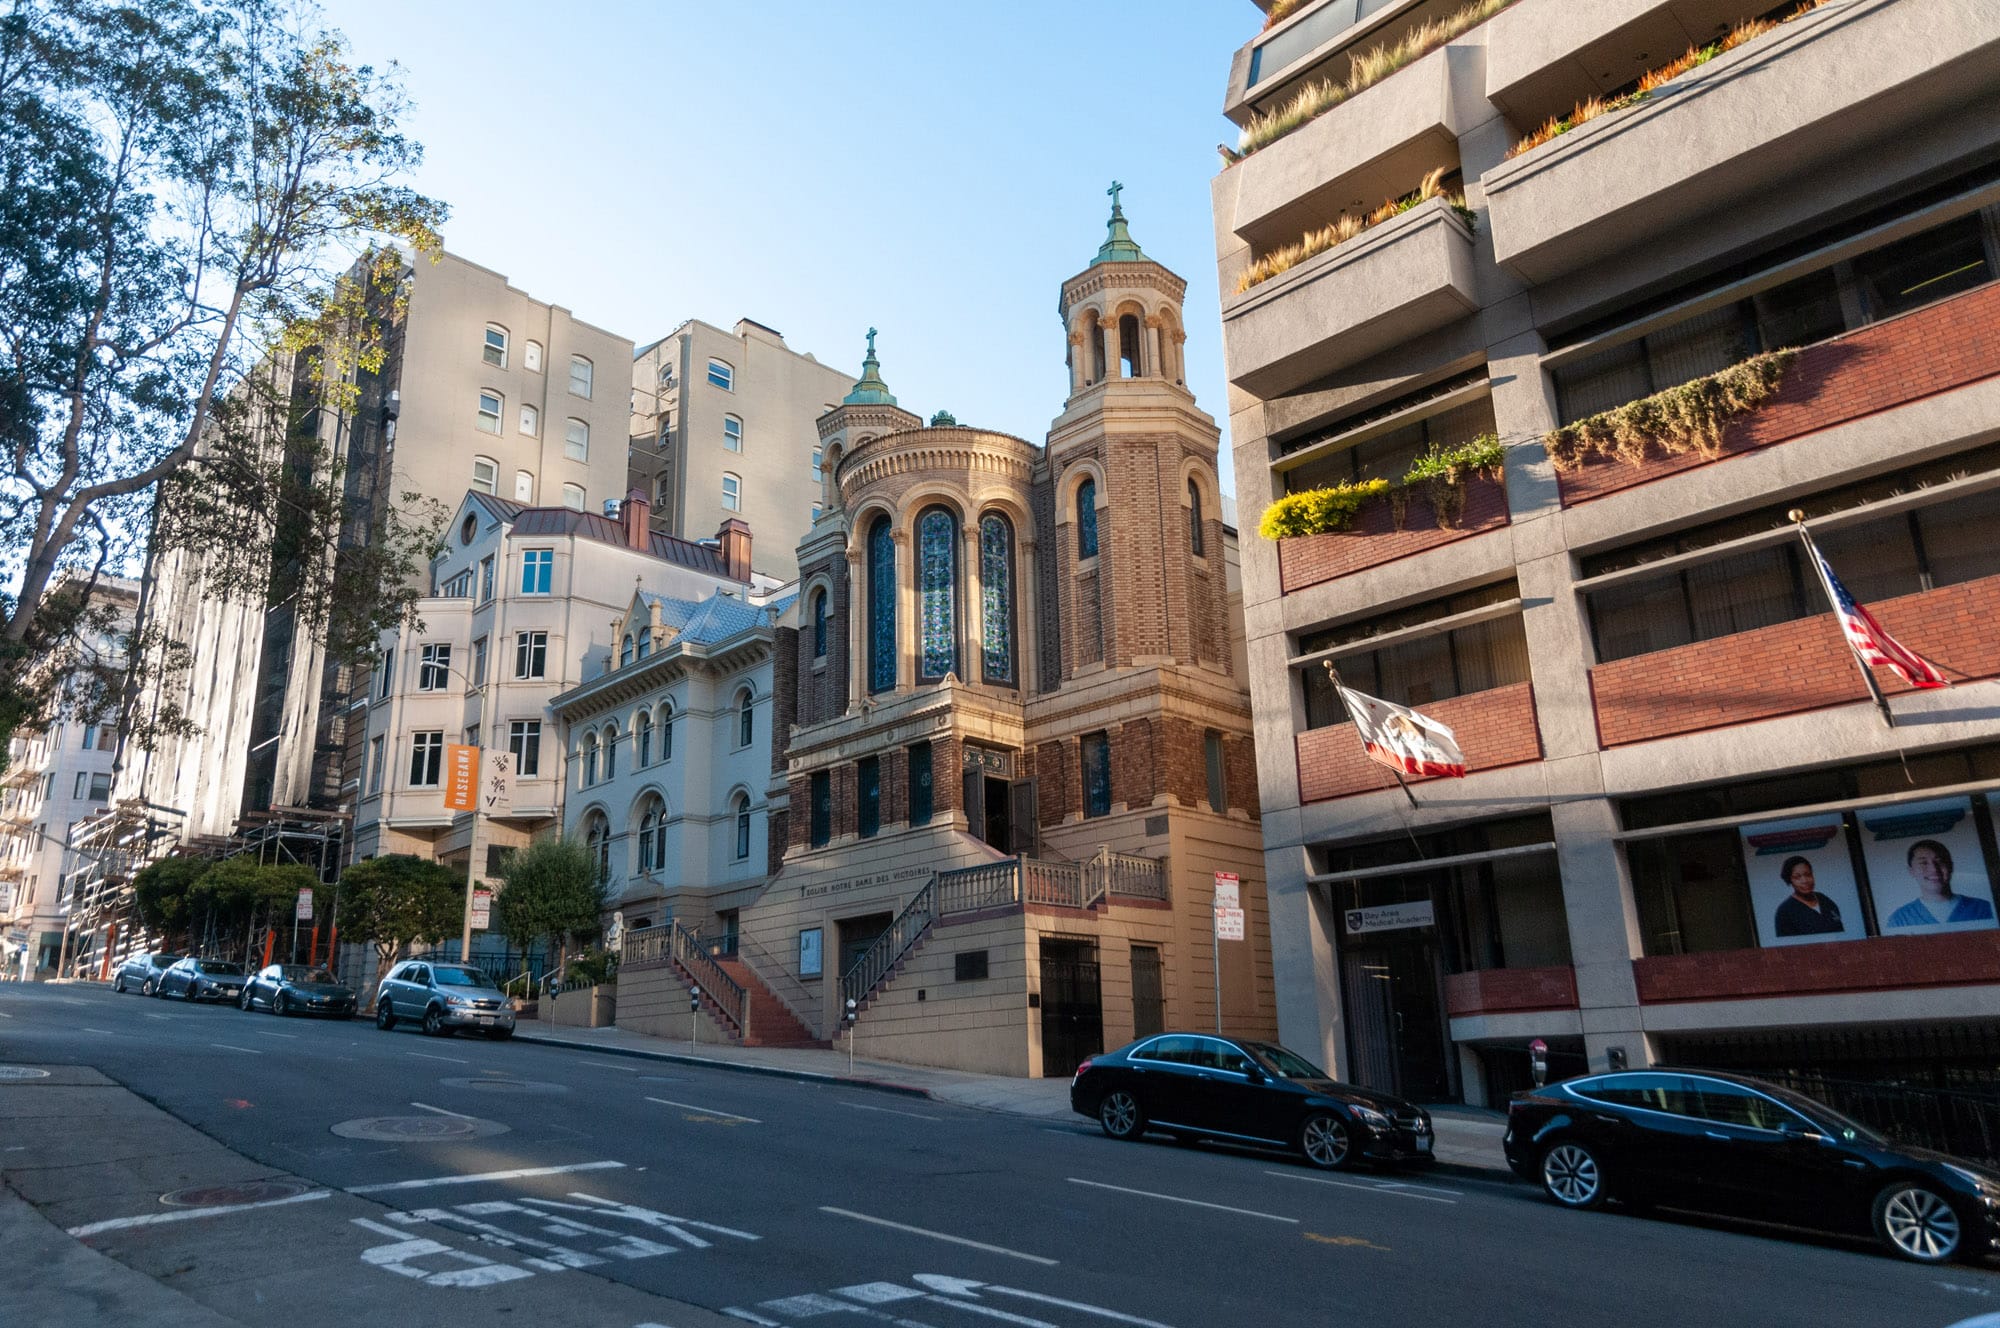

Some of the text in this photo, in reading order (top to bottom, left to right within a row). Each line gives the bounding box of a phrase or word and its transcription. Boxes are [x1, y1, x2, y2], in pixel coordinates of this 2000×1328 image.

[454, 750, 470, 805] HASEGAWA
[832, 881, 851, 891] NOTRE
[855, 877, 873, 886] DAME
[876, 874, 889, 883] DES
[894, 867, 929, 879] VICTOIRES
[1364, 912, 1379, 920] Bay
[1365, 914, 1432, 927] Medical Academy
